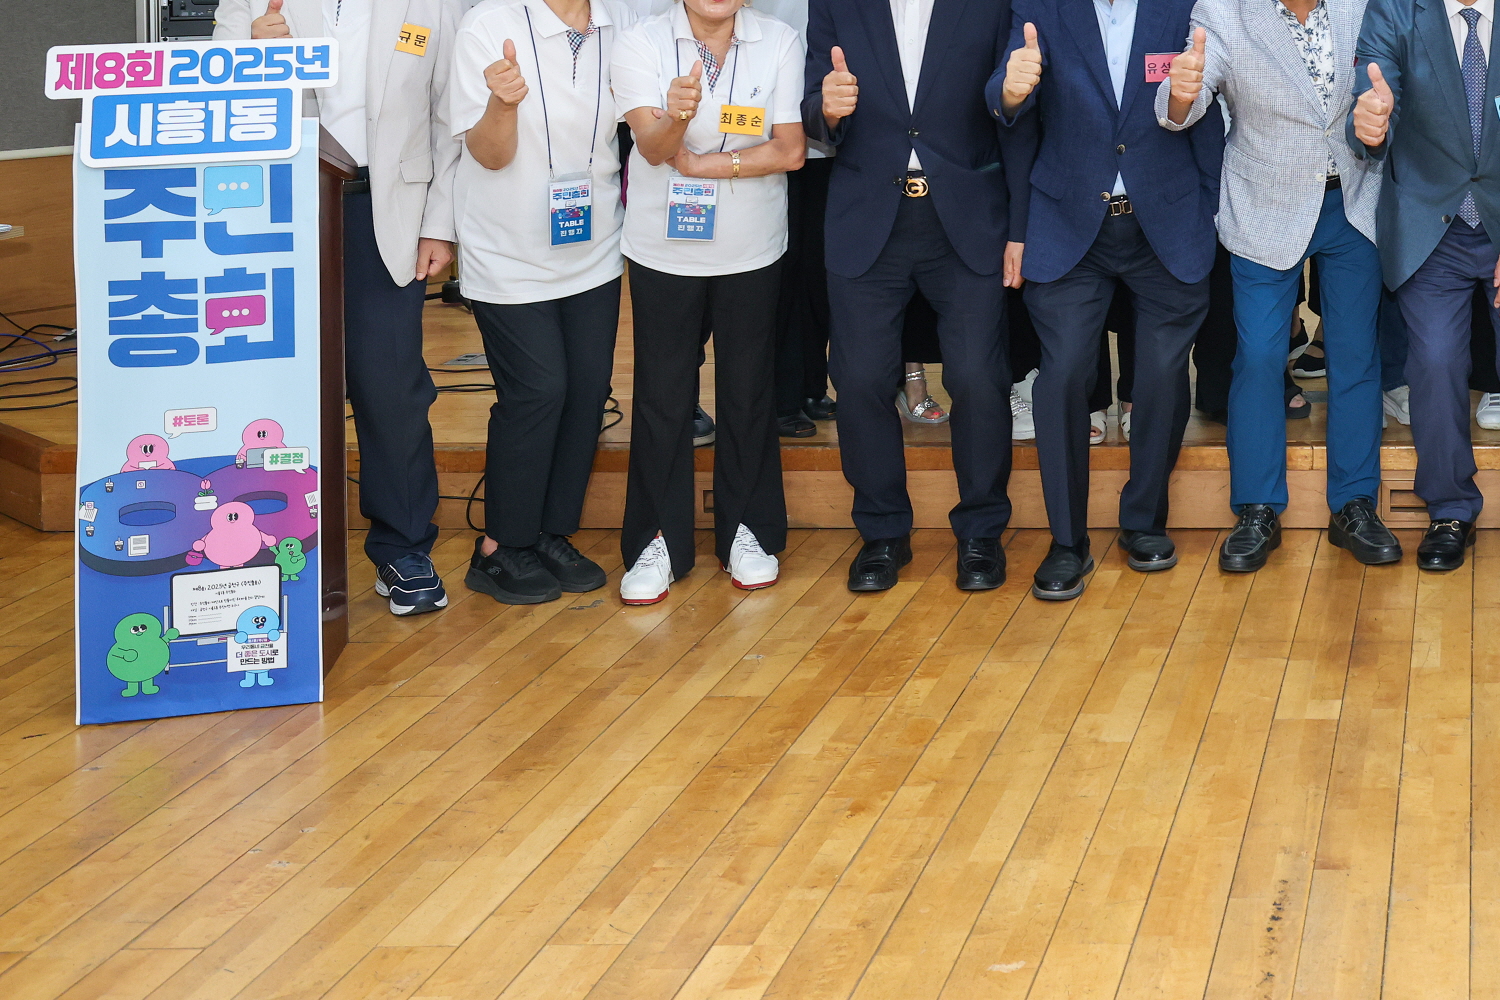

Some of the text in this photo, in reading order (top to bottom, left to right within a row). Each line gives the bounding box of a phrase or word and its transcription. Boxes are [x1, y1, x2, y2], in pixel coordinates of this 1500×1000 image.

[399, 30, 427, 48] 규문
[55, 44, 331, 91] 제8회 2025년
[1147, 62, 1171, 75] 유성
[104, 98, 278, 148] 시흥1동
[720, 112, 762, 128] 최종순
[104, 163, 294, 259] 주민
[558, 219, 585, 229] TABLE
[676, 216, 706, 224] TABLE
[107, 267, 296, 369] 총회
[172, 412, 210, 428] #토론
